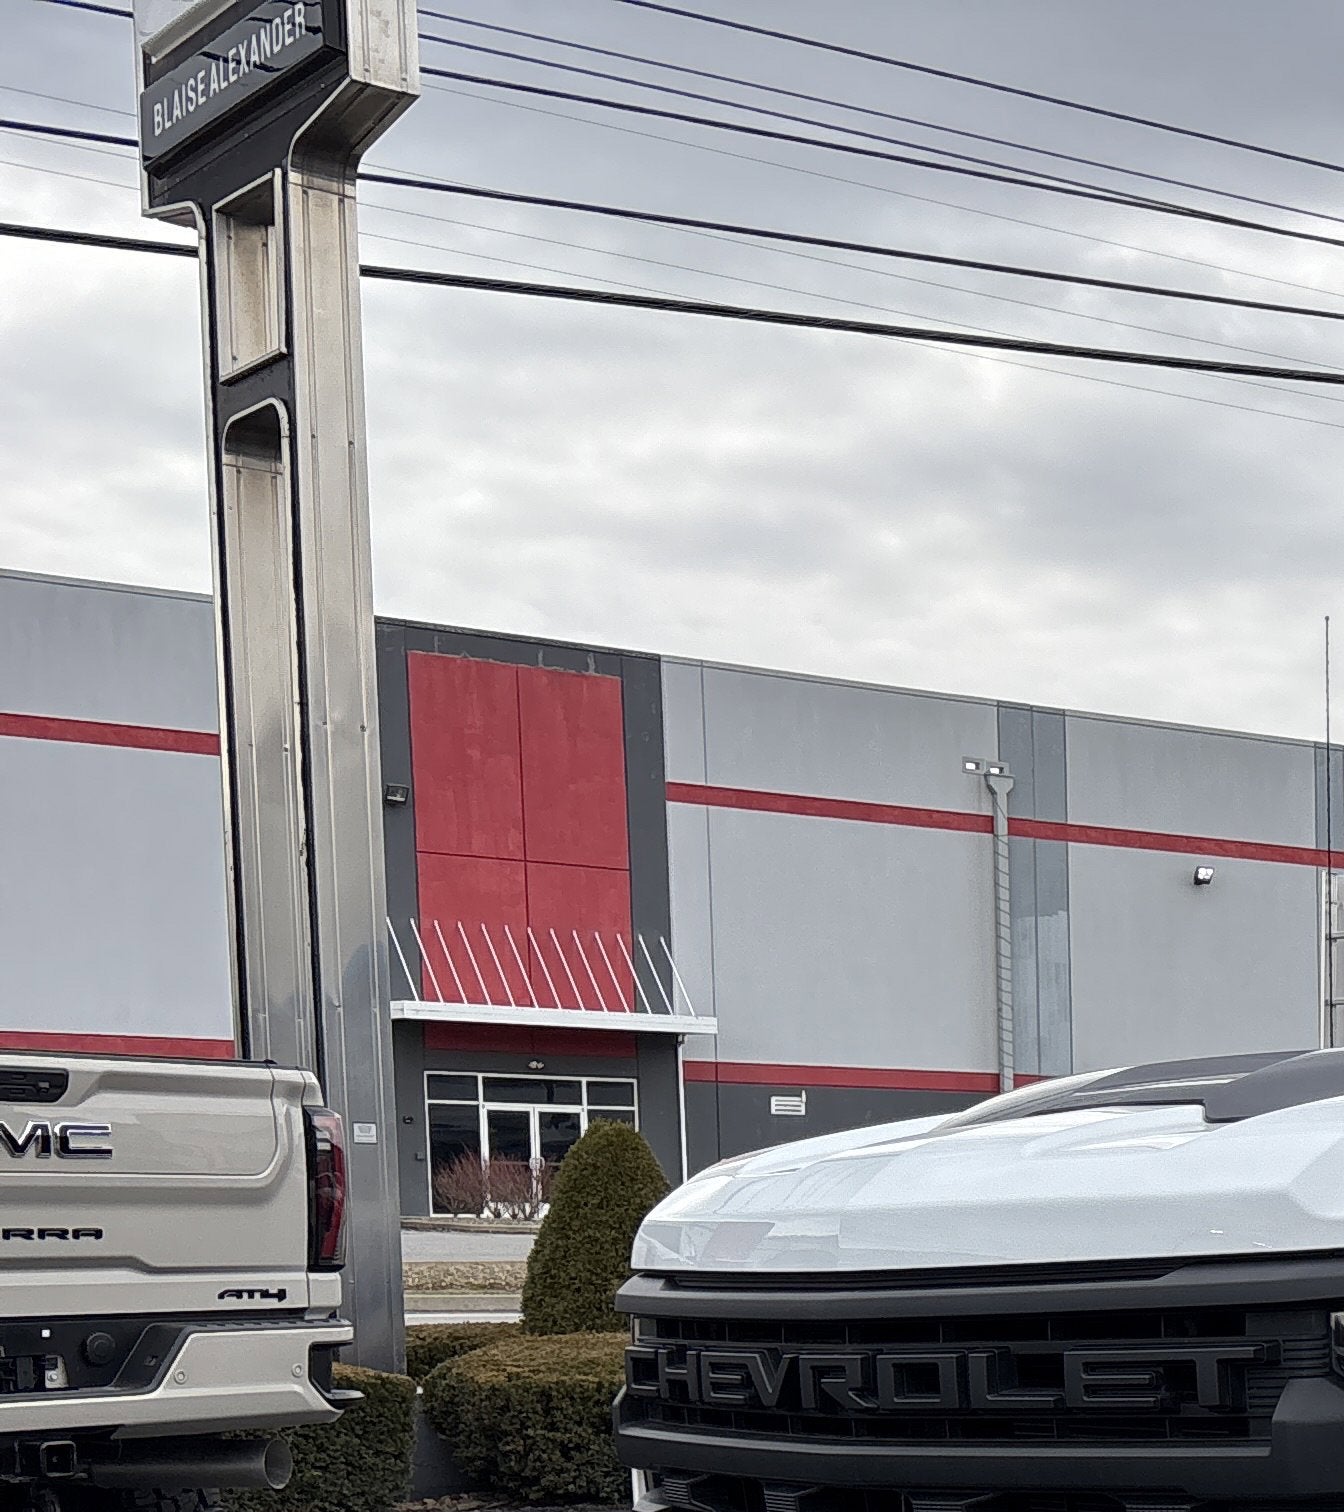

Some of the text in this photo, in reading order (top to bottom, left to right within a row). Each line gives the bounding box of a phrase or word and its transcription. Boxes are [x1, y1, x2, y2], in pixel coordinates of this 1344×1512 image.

[154, 3, 306, 136] BLAISE ALEXANDER
[217, 1288, 287, 1302] AT4
[624, 1343, 1280, 1412] CHEVROLET
